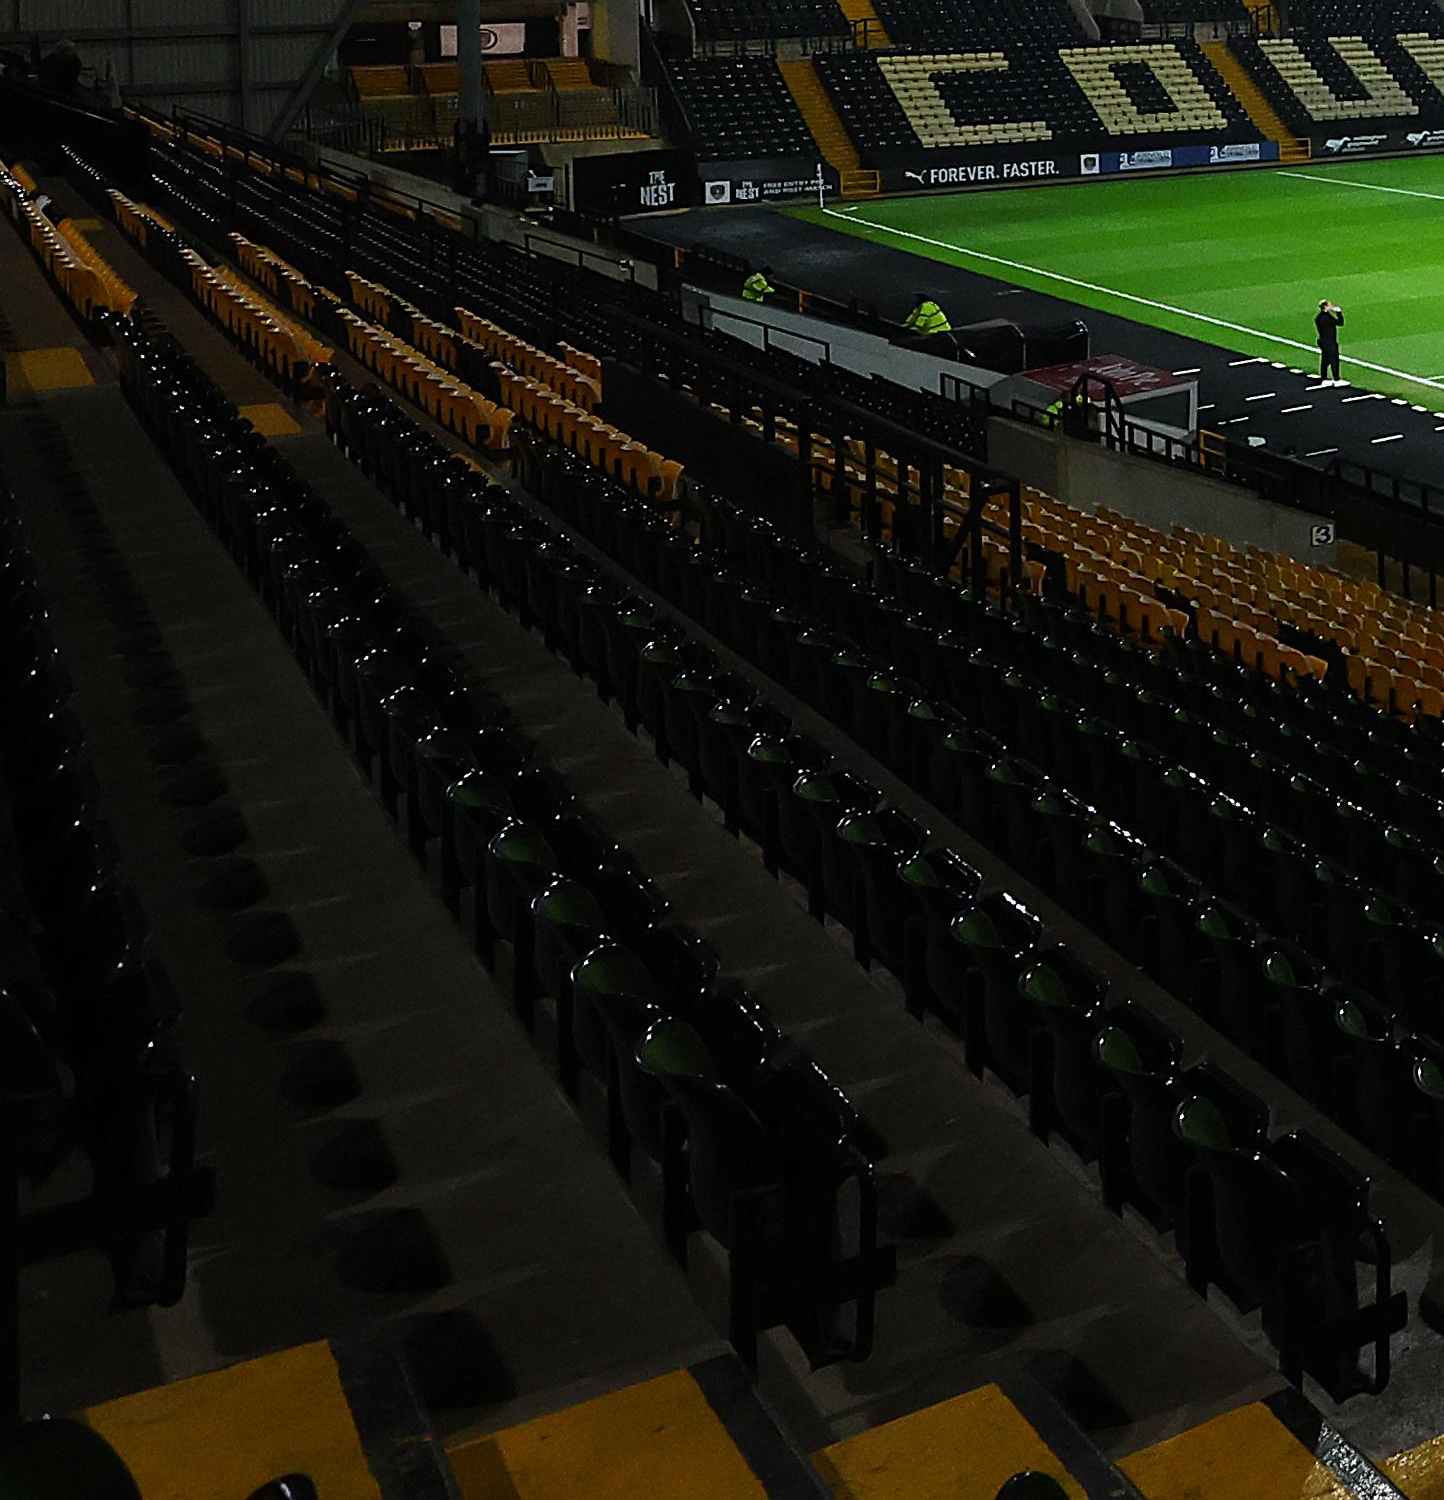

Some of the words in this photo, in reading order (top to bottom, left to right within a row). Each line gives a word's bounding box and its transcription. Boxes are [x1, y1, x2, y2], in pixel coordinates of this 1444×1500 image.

[648, 170, 666, 184] THE
[930, 164, 1000, 184] FOREVER.
[1003, 160, 1060, 180] FASTER.
[640, 182, 676, 208] NEST
[1315, 526, 1331, 544] 3
